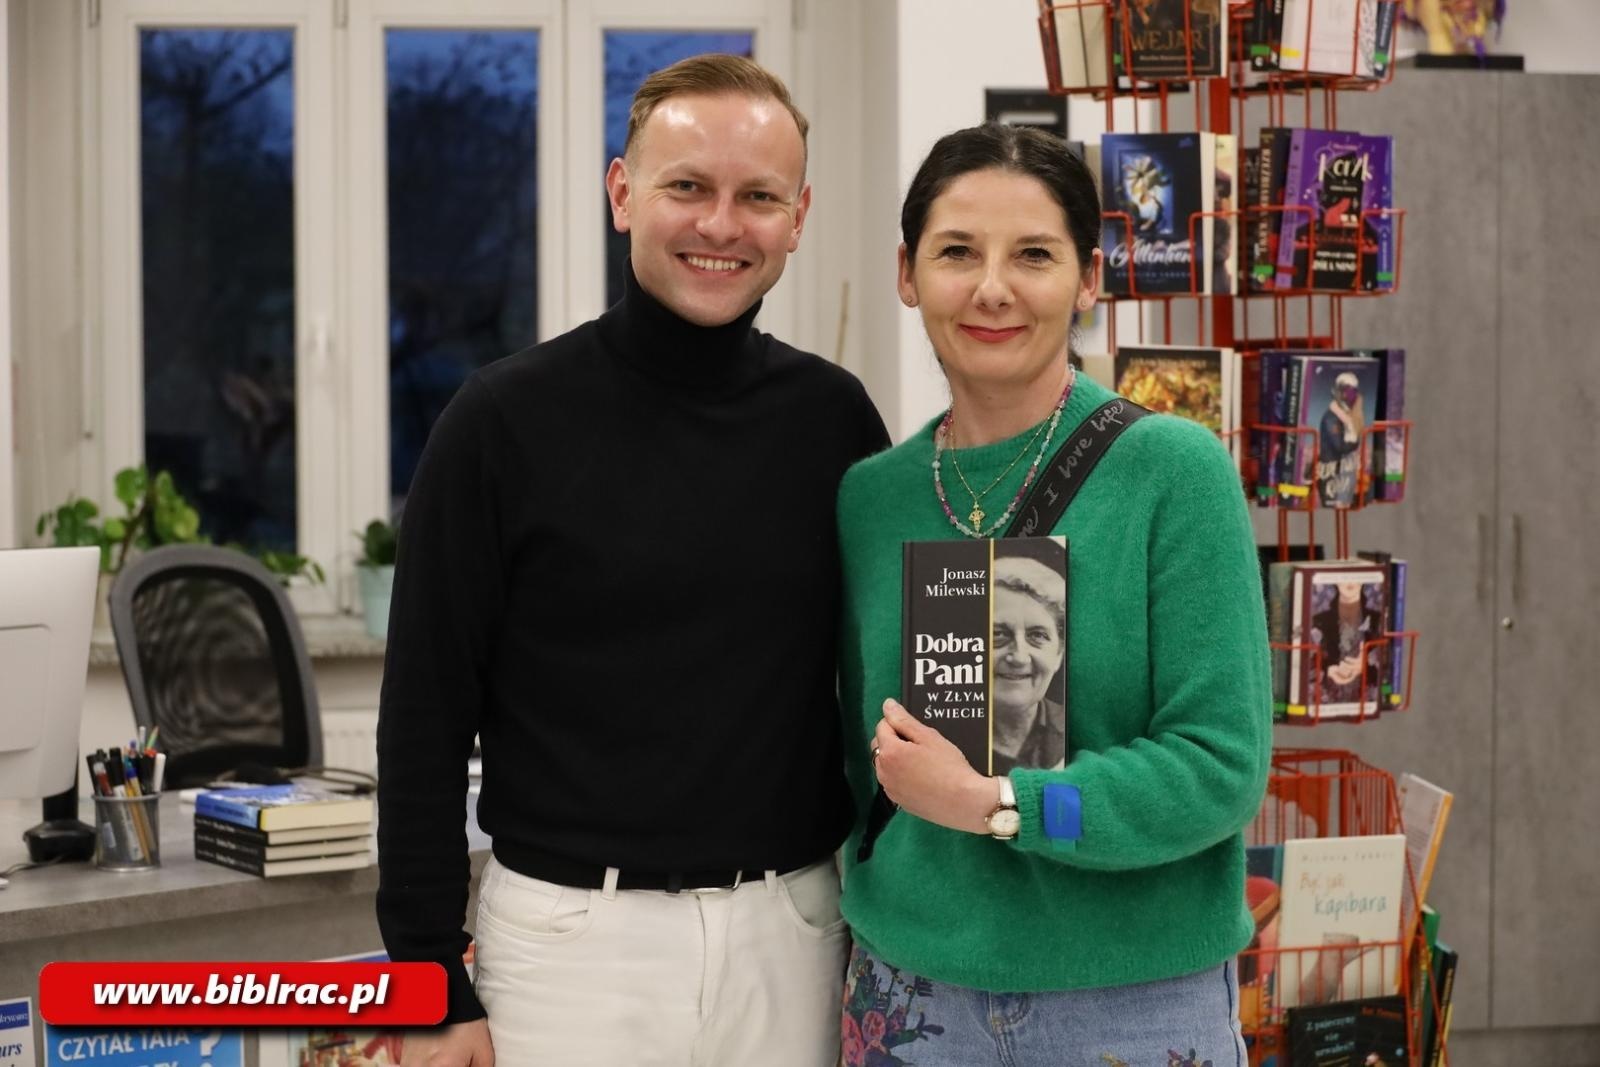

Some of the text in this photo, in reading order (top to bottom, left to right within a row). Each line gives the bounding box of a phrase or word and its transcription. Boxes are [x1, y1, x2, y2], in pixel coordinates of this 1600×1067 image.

[940, 568, 986, 584] Jonasz
[925, 583, 985, 597] Milewski
[915, 632, 985, 654] Dobra
[914, 654, 984, 686] Pani
[944, 690, 985, 702] ZŁYM
[924, 704, 985, 719] ŚWIECIE
[58, 1033, 134, 1061] CZYTAŁ
